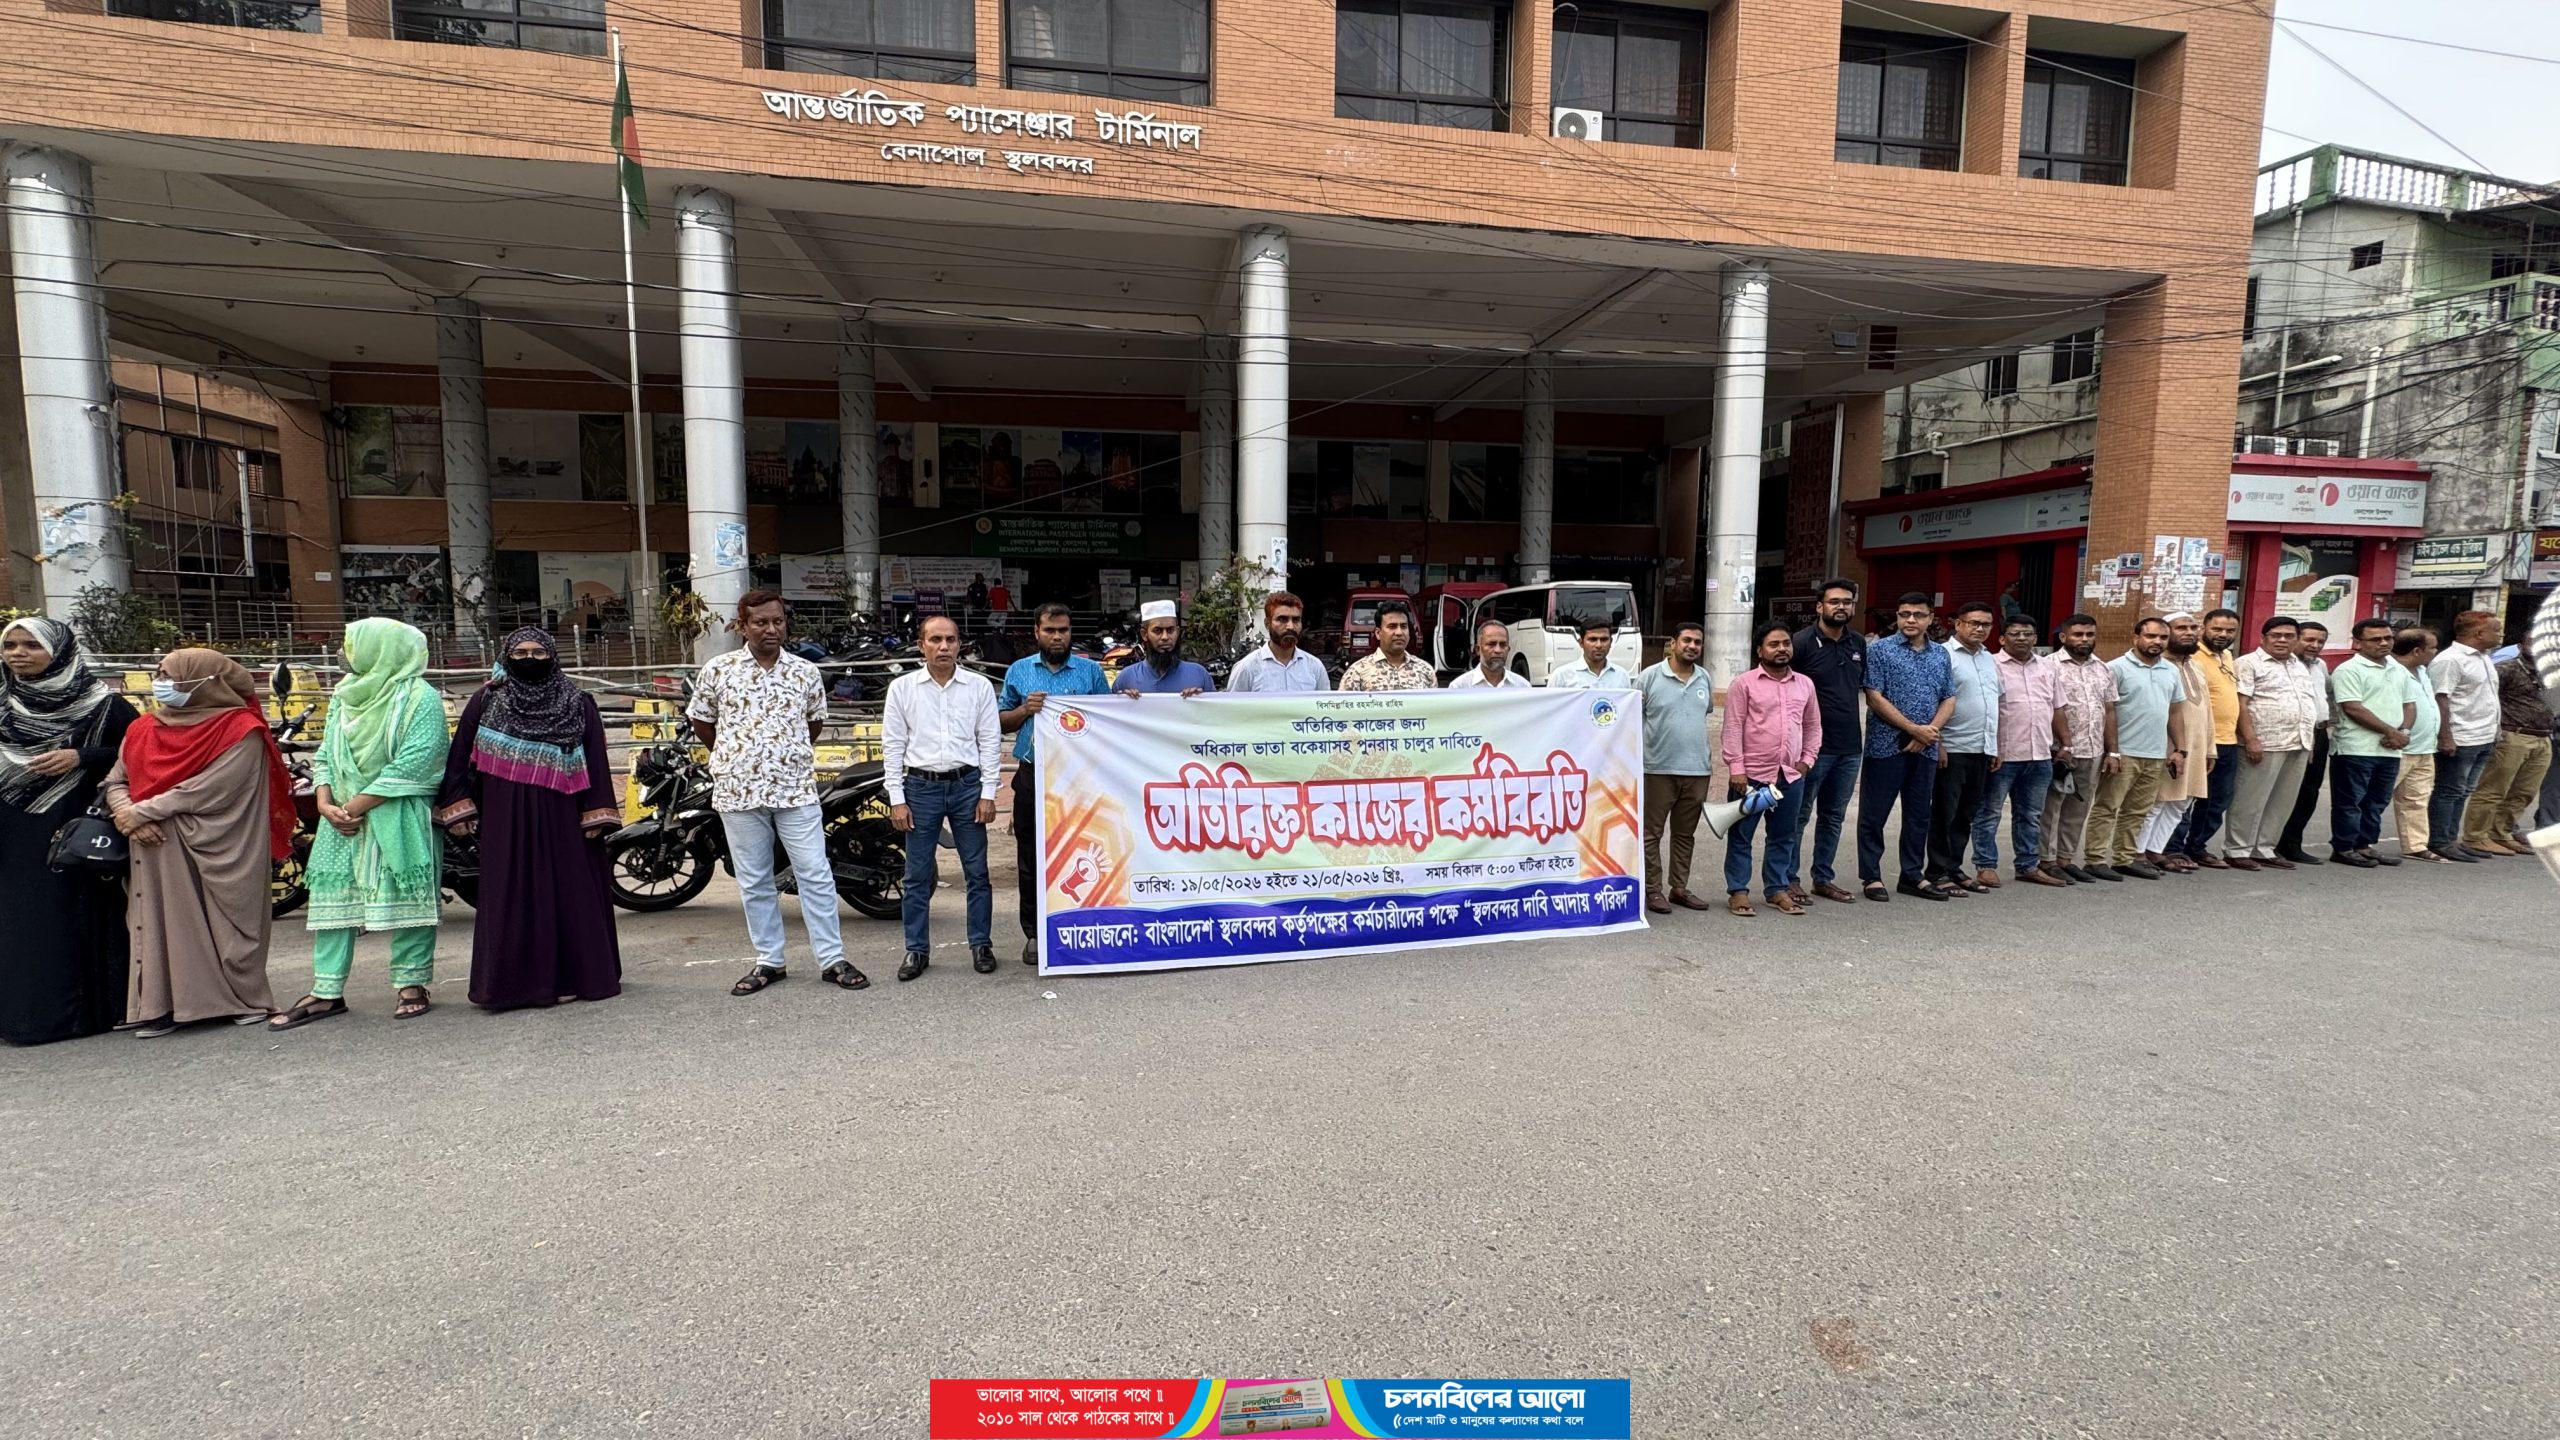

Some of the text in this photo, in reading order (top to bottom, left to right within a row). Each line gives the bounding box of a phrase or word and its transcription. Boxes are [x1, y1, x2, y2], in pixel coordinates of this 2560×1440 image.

[761, 88, 1202, 151] আন্তর্জাতিক প্যাসেঞ্জার টার্মিনাল
[881, 141, 1095, 175] বেনাপোল স্থলবন্দর
[2347, 484, 2420, 501] ওয়ান ব্যাংক
[1048, 530, 1087, 538] PASSENGER
[1291, 716, 1427, 734] অতিরিক্ত কাজের জন্য
[1190, 732, 1483, 757] অধিকাল ভাতা বকেয়াসহ পুনরায় চালুর দাবিতে
[1146, 744, 1588, 858] অতিরিক্ত কাজের কর্মবিরতি
[1425, 855, 1575, 880] সময় বিকাল ৫:০০ ঘটিকা হইতে
[1182, 875, 1261, 893] ১৯/০৫/২০২৬
[1265, 872, 1298, 889] হইতে
[1303, 869, 1379, 889] ২১/০৫/২০২৬
[1144, 917, 1214, 946] বাংলাদেশ
[1218, 916, 1277, 947] স্থলবন্দর
[1280, 905, 1348, 946] কর্তৃপক্ষের
[1352, 900, 1425, 931] কর্মচারীদের
[1429, 904, 1460, 926] পক্ষে
[1523, 889, 1548, 919] দাবি
[1552, 892, 1590, 915] আদায়
